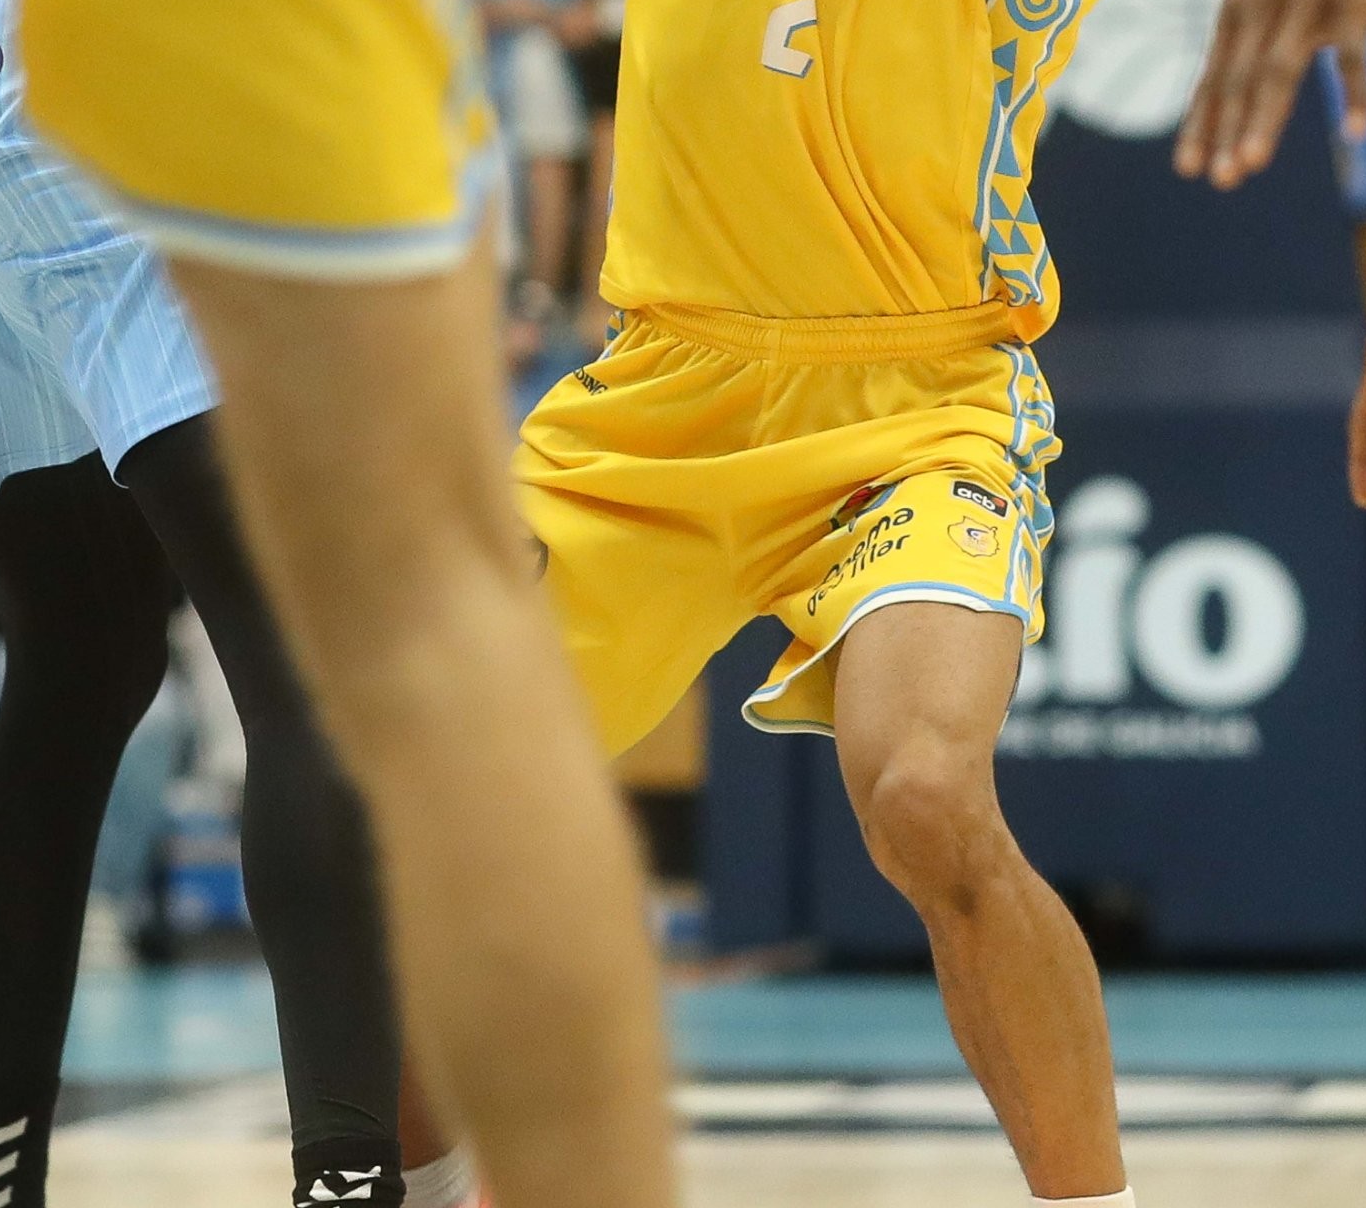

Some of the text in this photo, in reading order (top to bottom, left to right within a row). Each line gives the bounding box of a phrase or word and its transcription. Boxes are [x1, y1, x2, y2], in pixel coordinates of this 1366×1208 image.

[572, 365, 609, 396] DING
[956, 486, 998, 512] acb
[1013, 476, 1304, 708] ío
